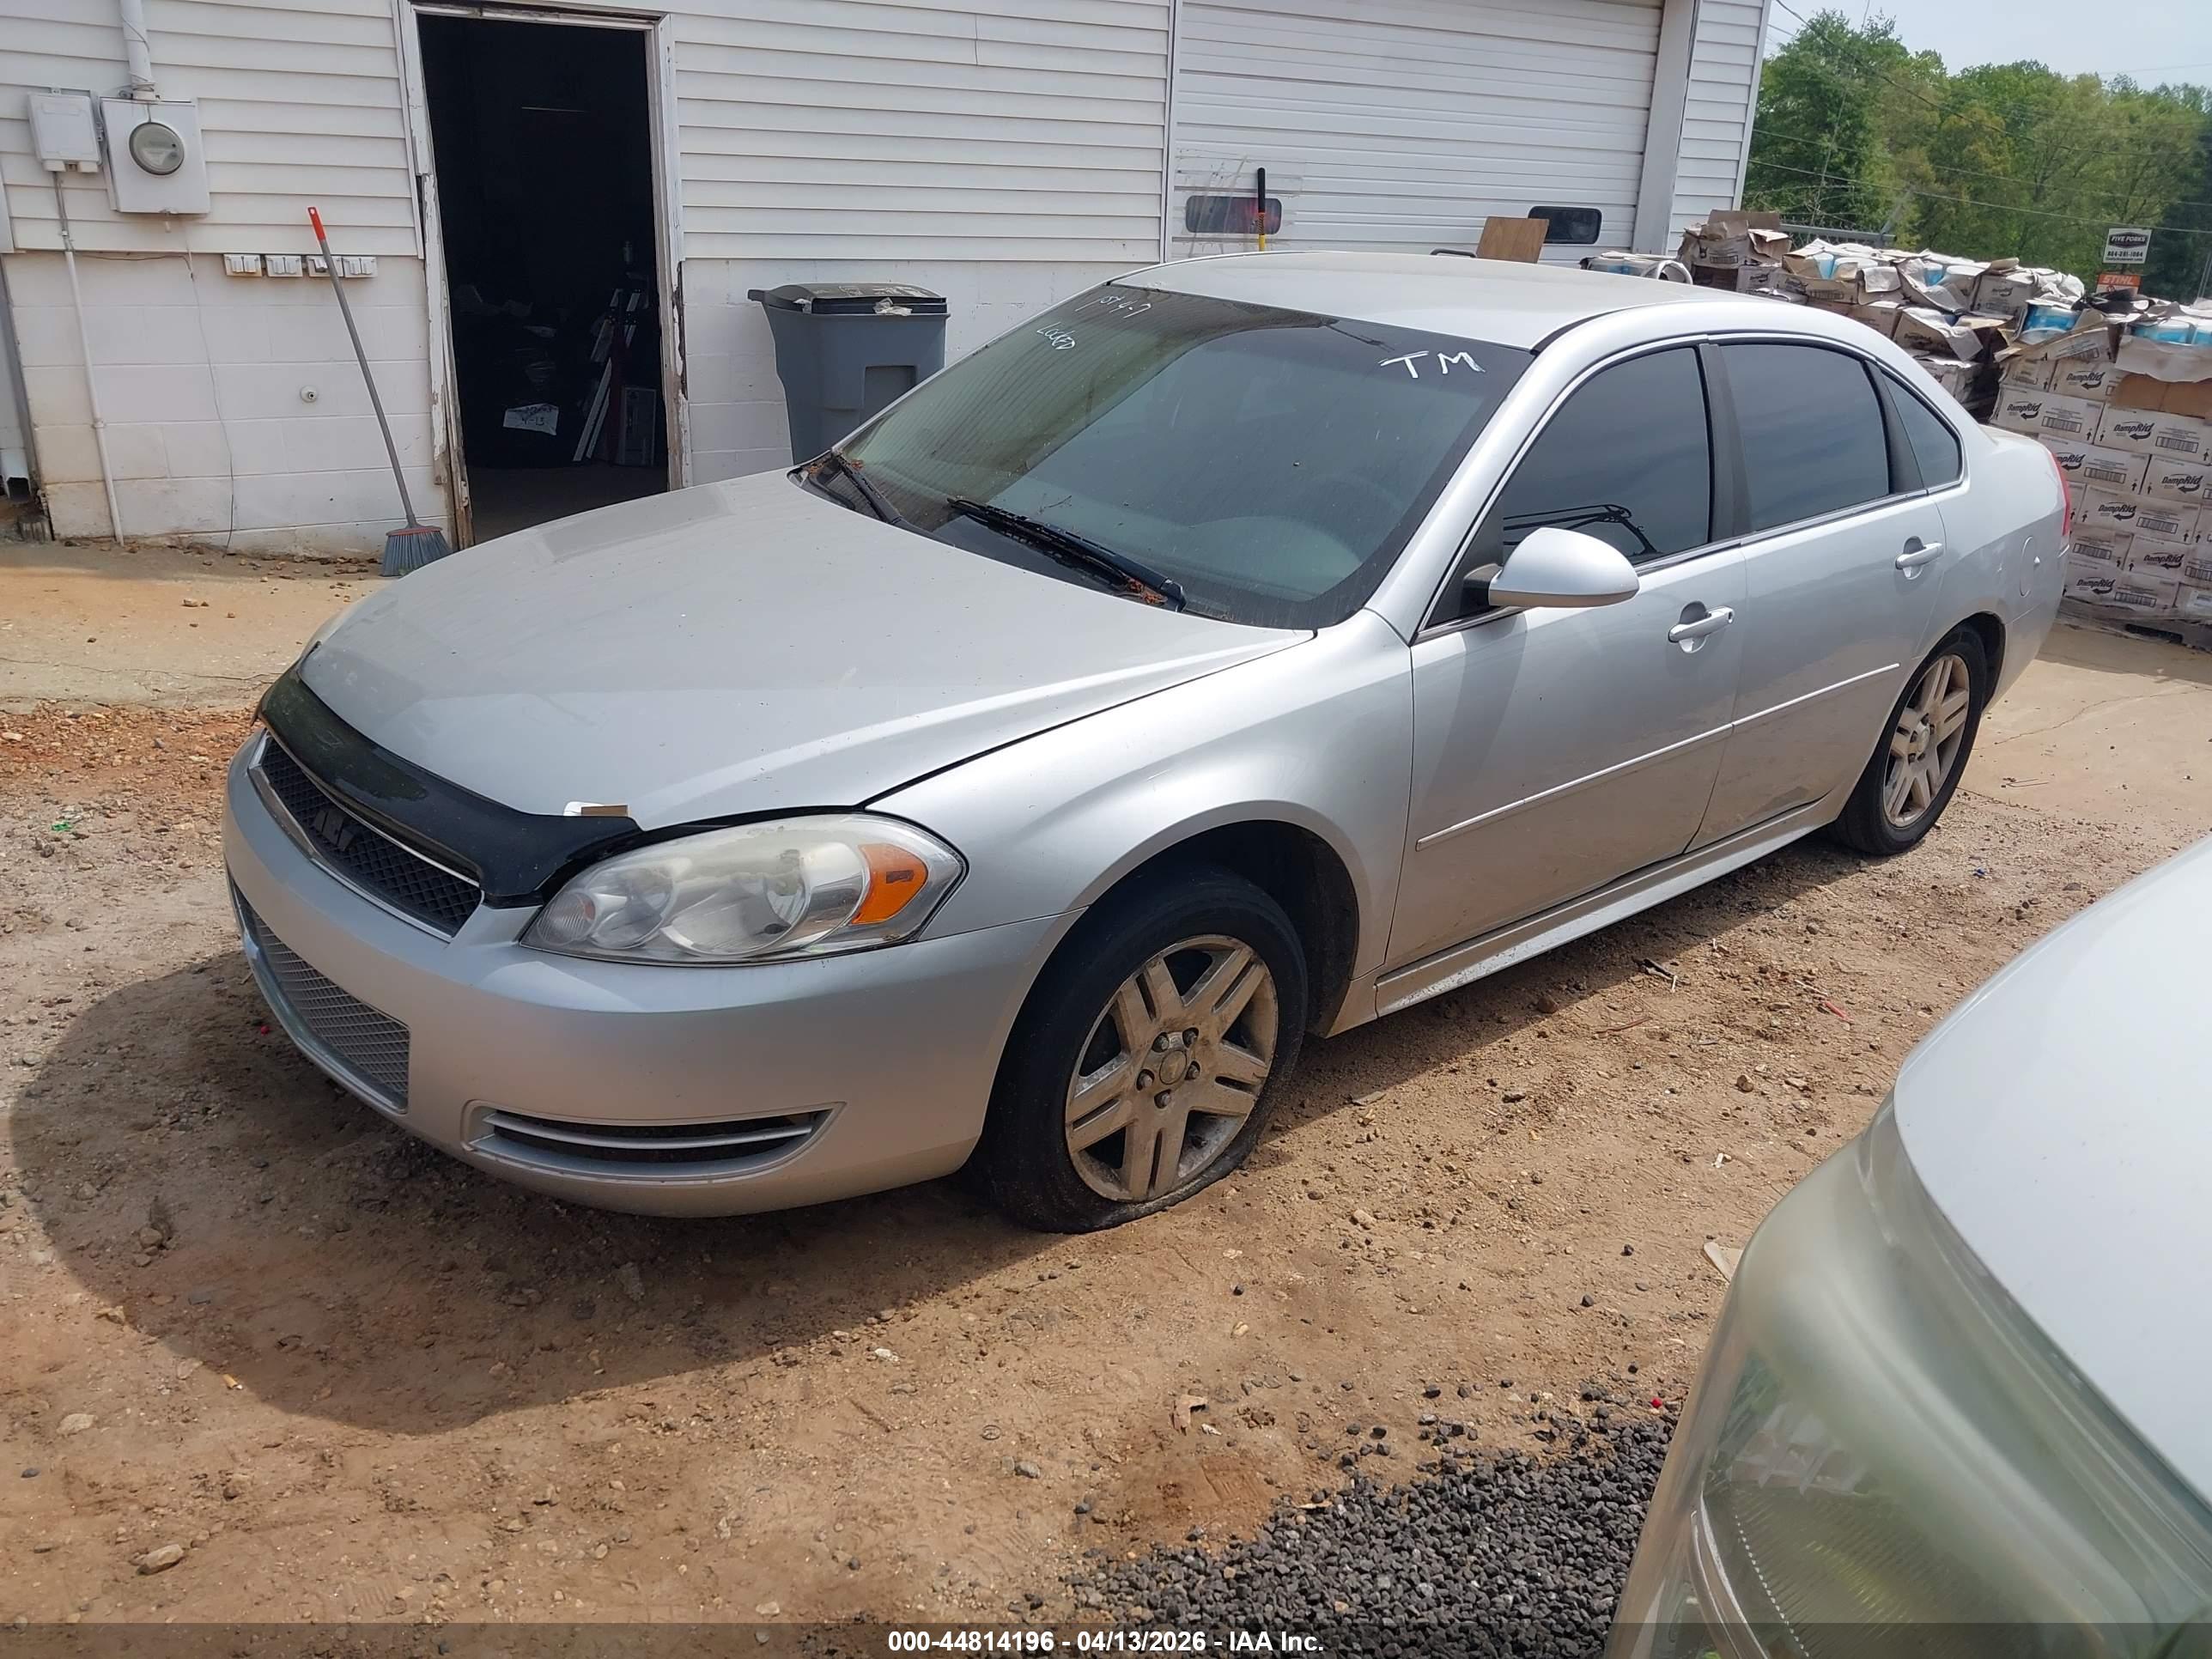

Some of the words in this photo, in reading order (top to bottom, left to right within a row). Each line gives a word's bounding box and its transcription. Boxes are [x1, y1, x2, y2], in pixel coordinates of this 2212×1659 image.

[2102, 275, 2134, 285] STIHL
[2066, 371, 2106, 383] DampRid
[2007, 402, 2043, 413] DampRid
[2113, 422, 2155, 434] DampRid
[2161, 475, 2203, 486] DampRid
[2098, 504, 2137, 515] DampRid
[2143, 553, 2185, 565] DampRid
[2076, 579, 2117, 589] DampRid
